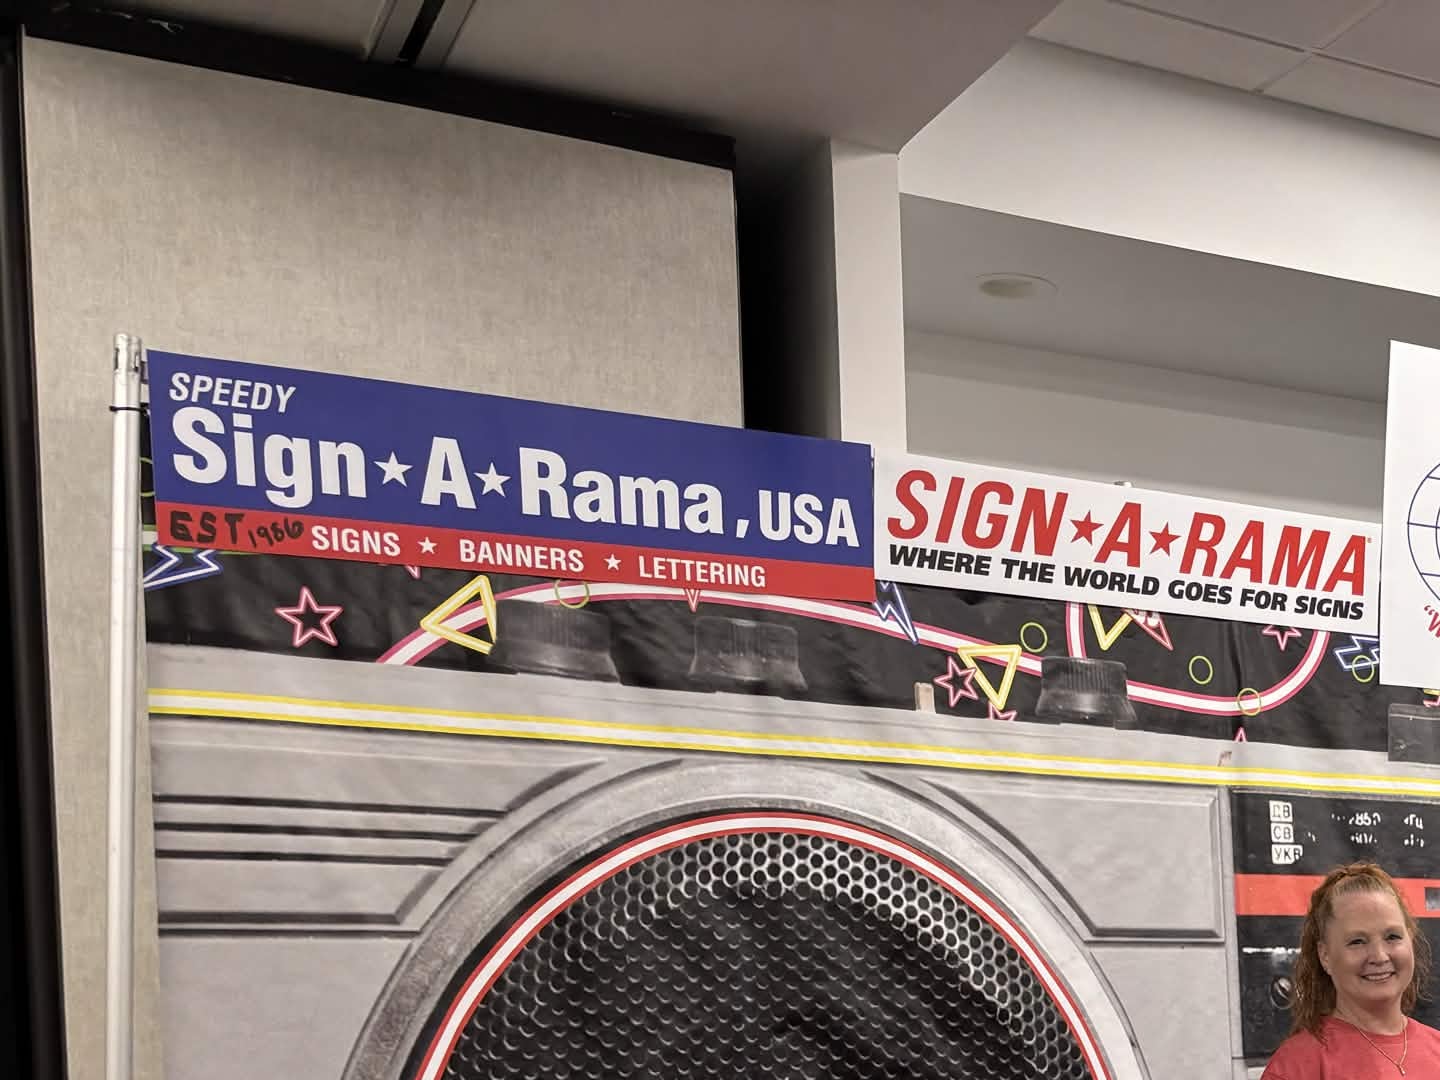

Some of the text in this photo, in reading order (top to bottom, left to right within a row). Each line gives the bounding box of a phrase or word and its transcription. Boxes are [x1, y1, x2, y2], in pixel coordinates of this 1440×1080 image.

[169, 372, 296, 413] SPEEDY
[171, 406, 368, 508] Sign
[759, 497, 860, 547] USA
[170, 510, 304, 548] EST 1986
[311, 525, 767, 588] SIGNS BANNERS LETTERING
[887, 468, 1068, 557] SIGN
[1178, 511, 1367, 597] RAMA
[889, 545, 1365, 621] WHERE THE WORLD GOES FOR SIGNS
